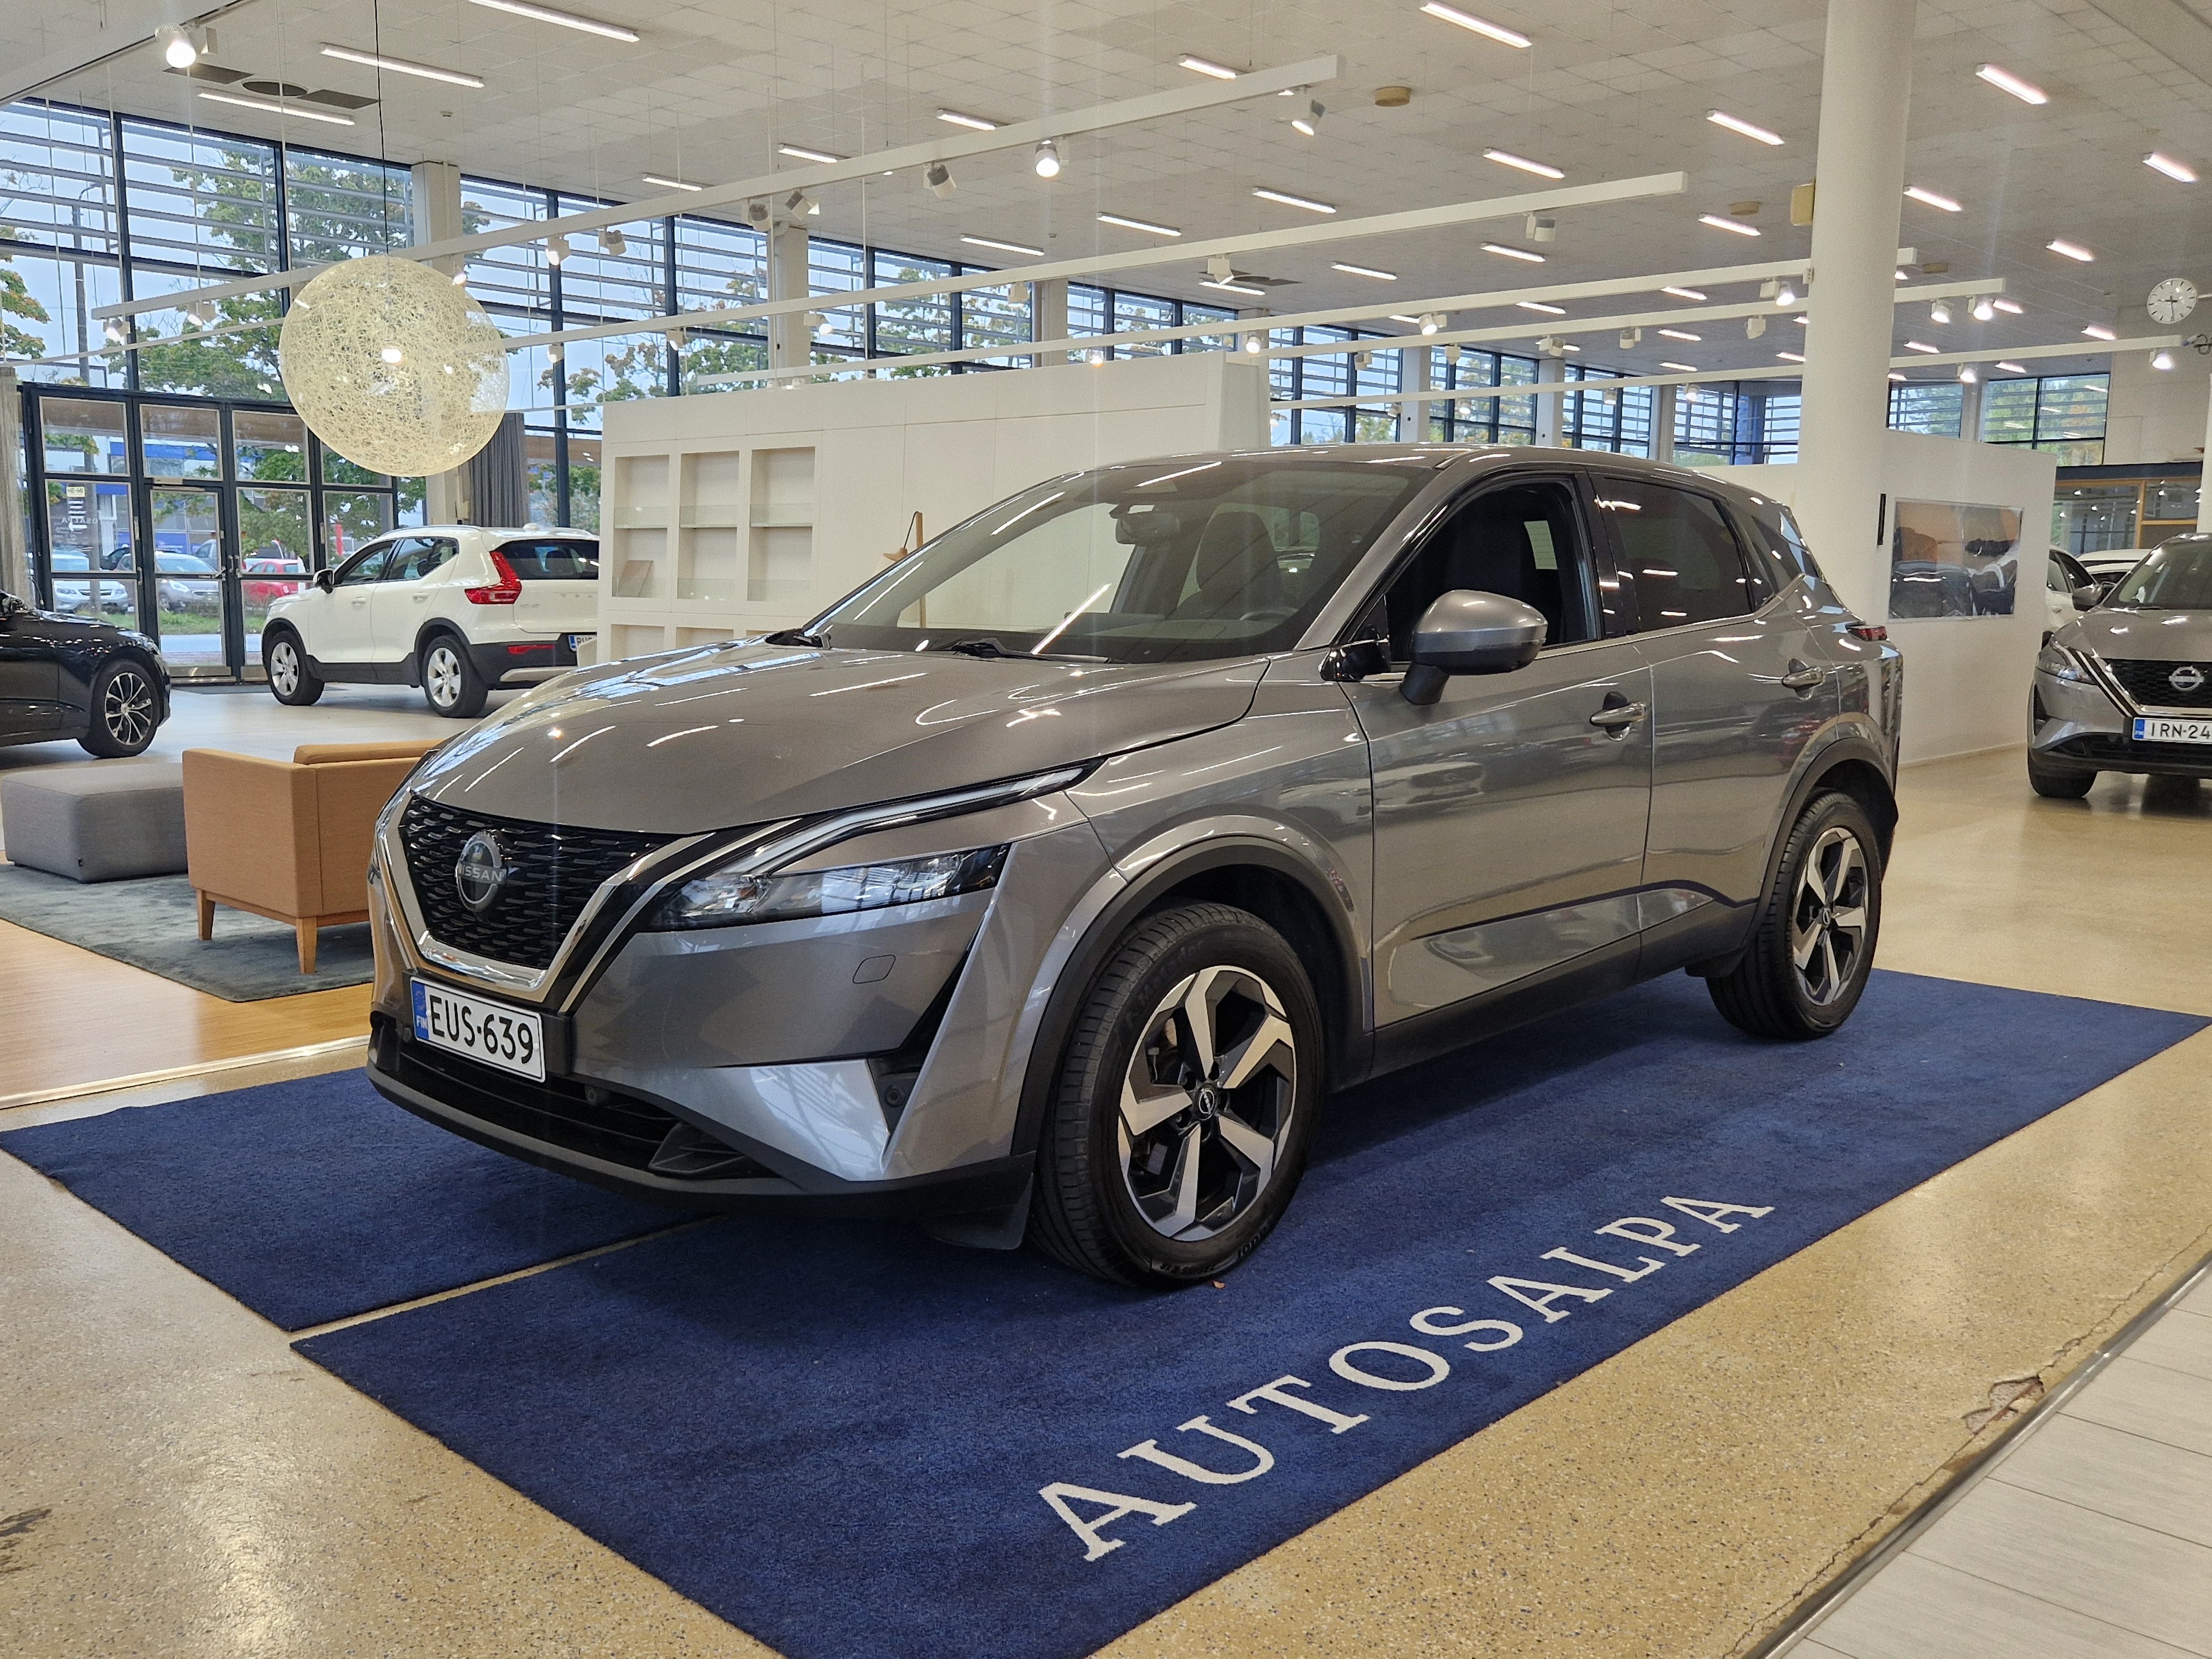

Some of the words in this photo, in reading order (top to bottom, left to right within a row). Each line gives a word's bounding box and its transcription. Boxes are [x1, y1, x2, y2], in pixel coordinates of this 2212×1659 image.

[457, 863, 503, 881] NISSAN
[416, 1015, 428, 1030] FIN
[429, 995, 534, 1064] EUS-639
[1039, 1196, 1775, 1562] AUTOSALPA
